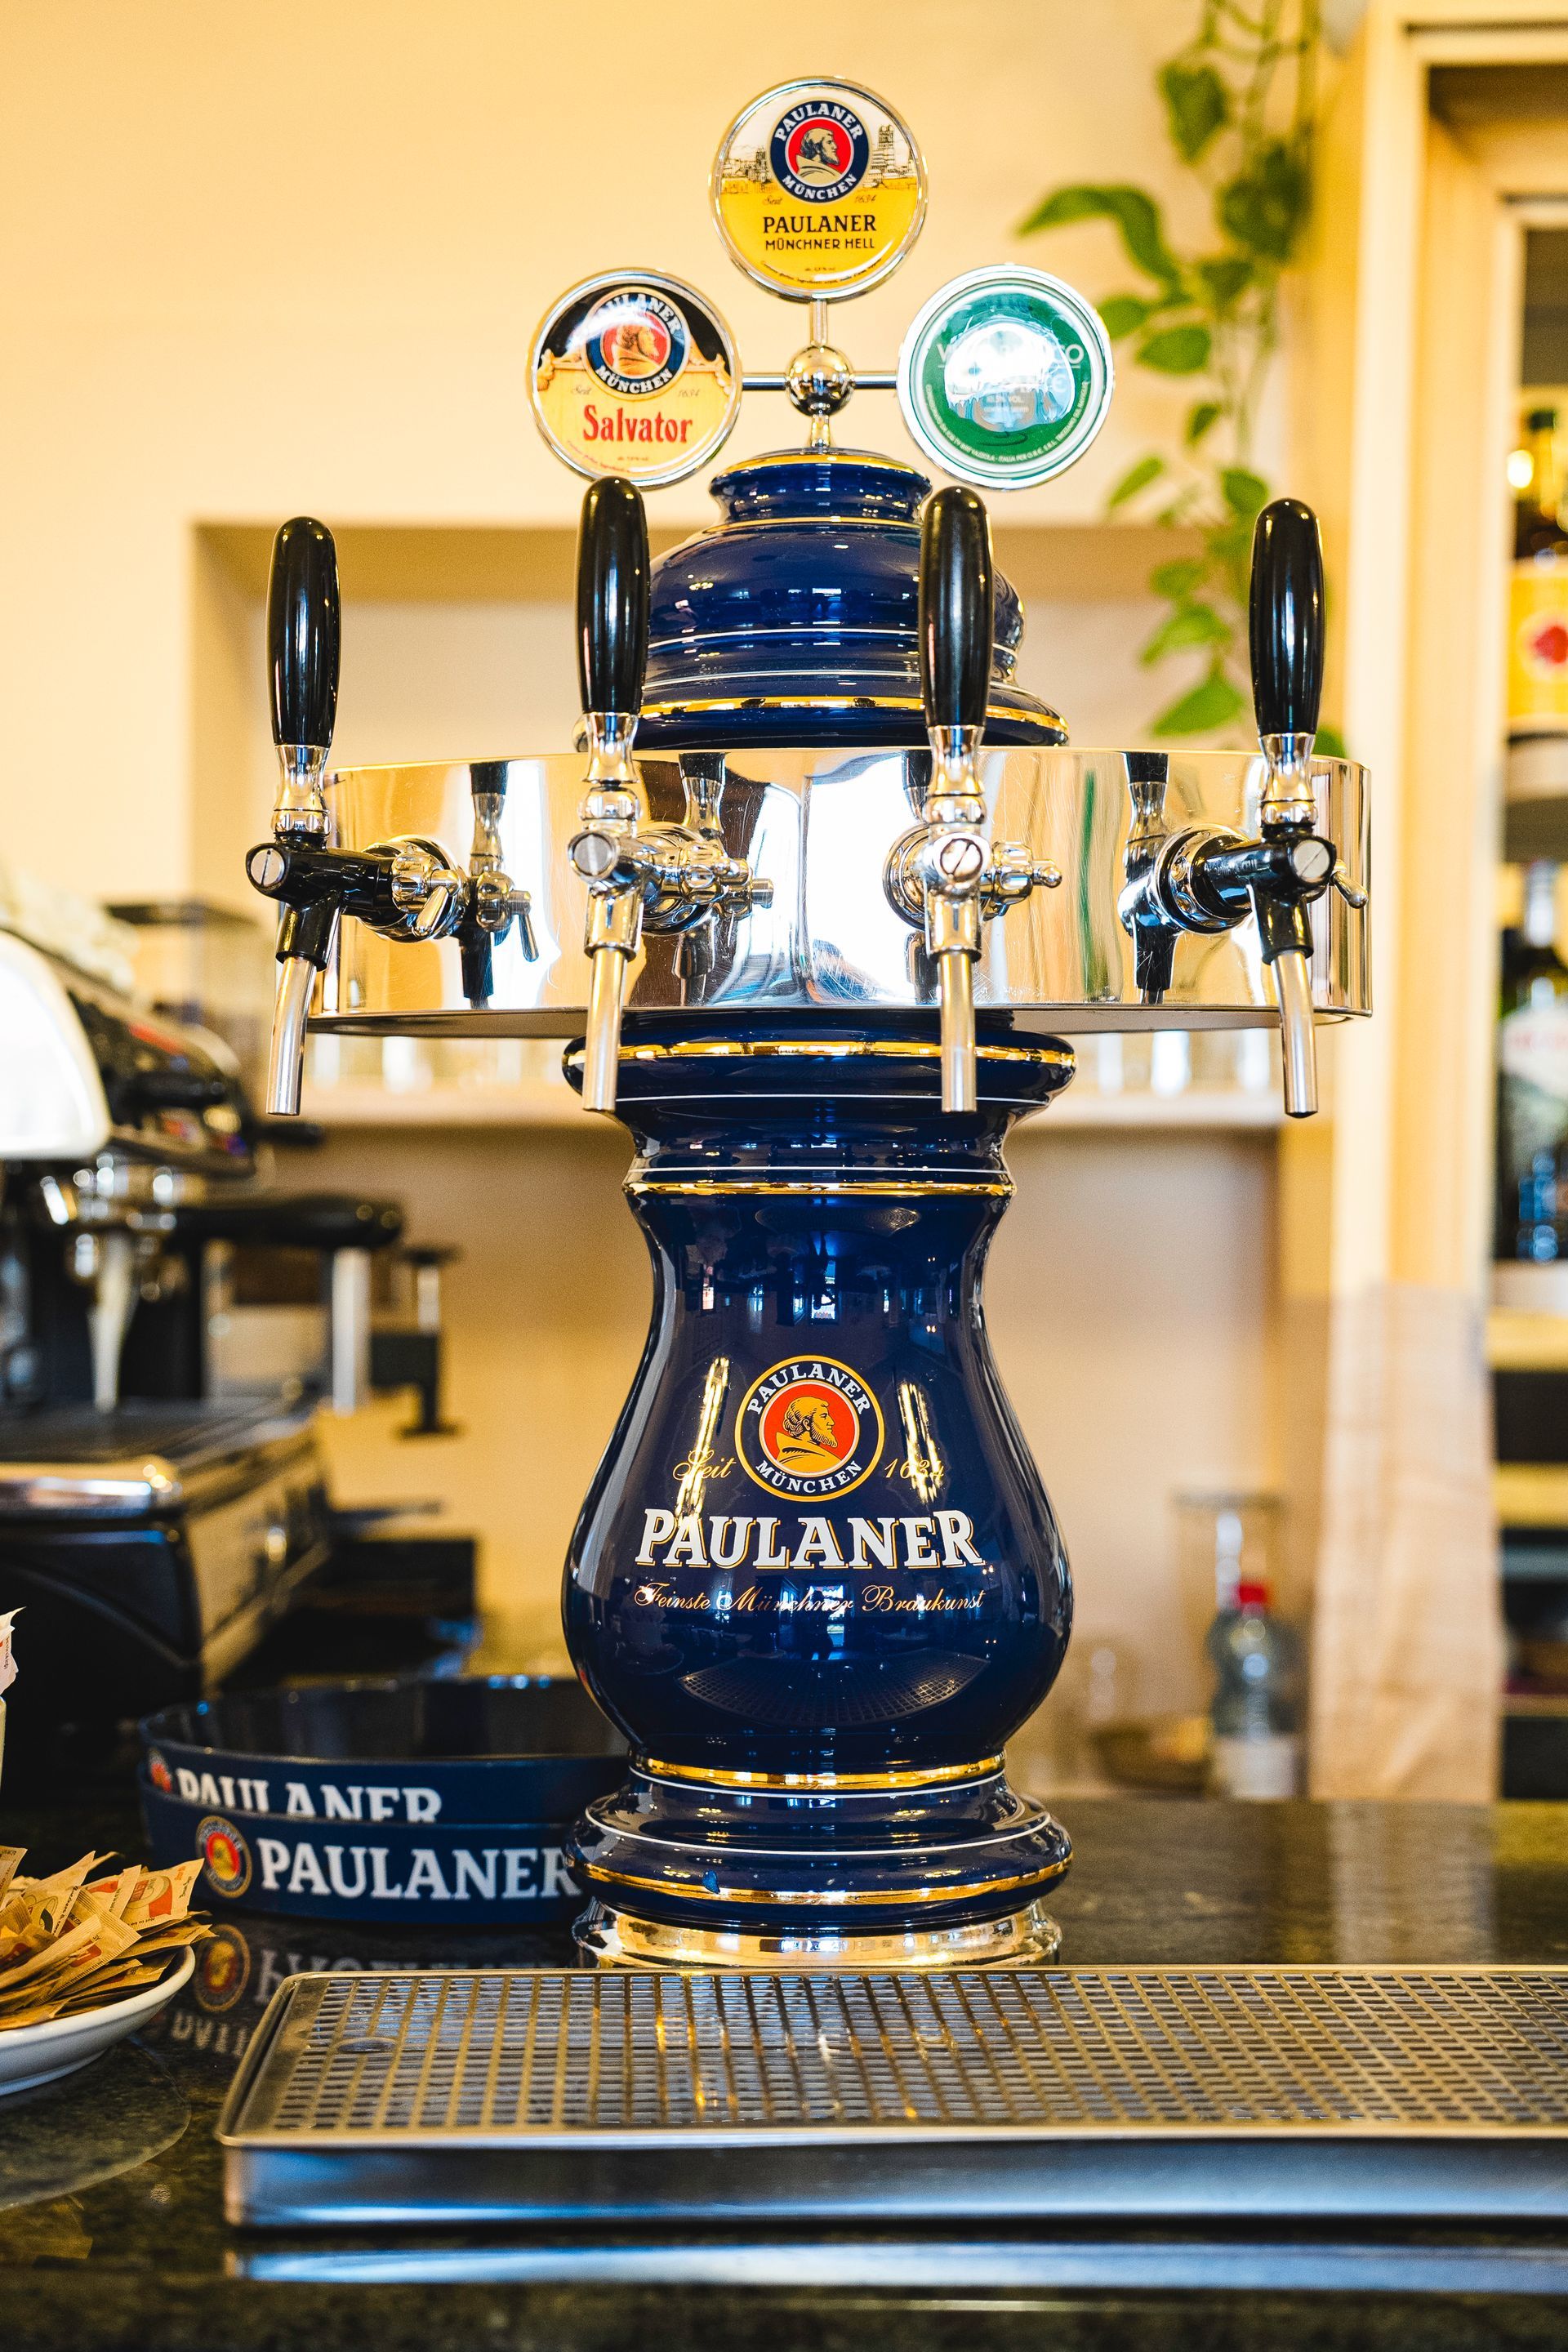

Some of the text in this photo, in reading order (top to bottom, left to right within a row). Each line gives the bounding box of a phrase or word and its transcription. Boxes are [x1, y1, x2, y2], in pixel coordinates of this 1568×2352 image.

[774, 103, 863, 141] PAULANER
[782, 173, 857, 201] MÜNCHEN
[763, 214, 877, 234] PAULANER
[765, 237, 875, 251] MÜNCHNER HELL
[595, 365, 673, 394] MÜNCHEN
[583, 403, 693, 443] Salvator
[747, 1363, 871, 1415] PAULANER
[672, 1449, 737, 1481] Seit
[755, 1459, 862, 1494] MÜNCHEN
[635, 1508, 986, 1570] PAULANER
[634, 1582, 987, 1612] Feinste Münchner Braukunst
[256, 1838, 583, 1899] PAULANER
